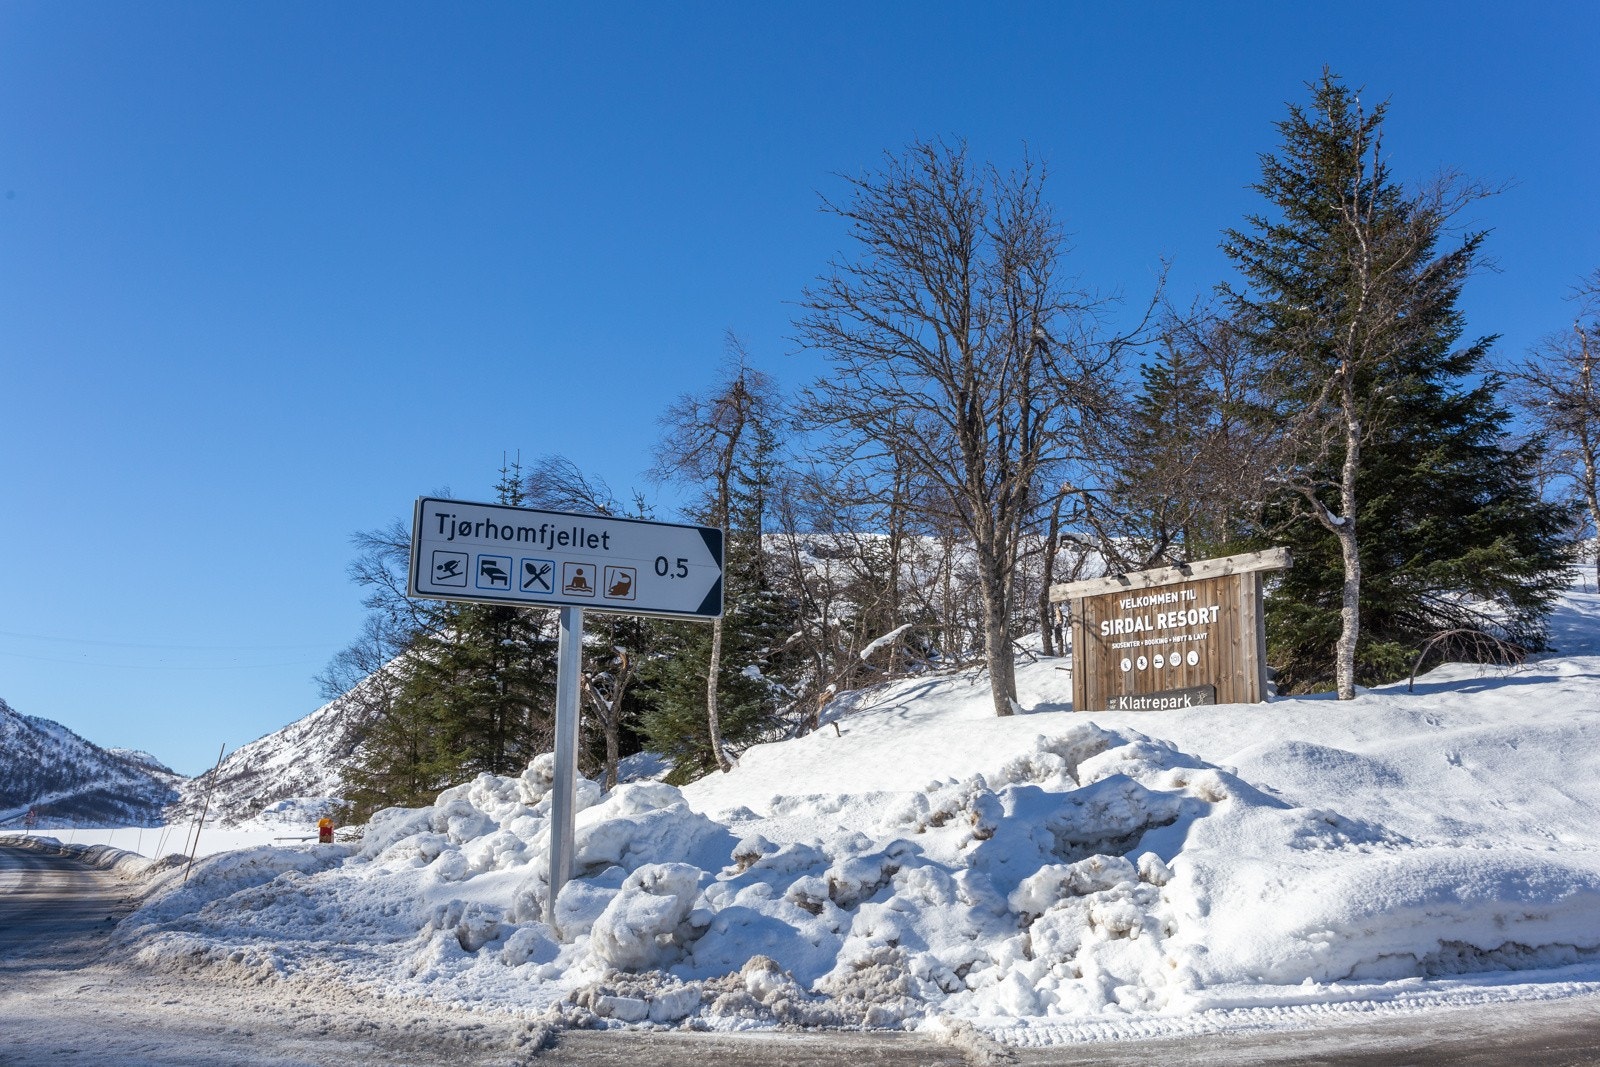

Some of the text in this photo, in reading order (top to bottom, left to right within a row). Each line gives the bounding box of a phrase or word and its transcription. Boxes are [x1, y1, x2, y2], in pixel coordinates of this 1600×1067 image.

[435, 513, 610, 550] Tjørhomfjellet
[654, 556, 689, 579] 0,5
[1120, 589, 1197, 610] VELKOMMEN TIL
[1101, 606, 1219, 636] SIRDAL RESORT
[1112, 640, 1140, 649] SKISENTER
[1144, 637, 1168, 646] BOOKING
[1120, 694, 1191, 710] Klatrepark
